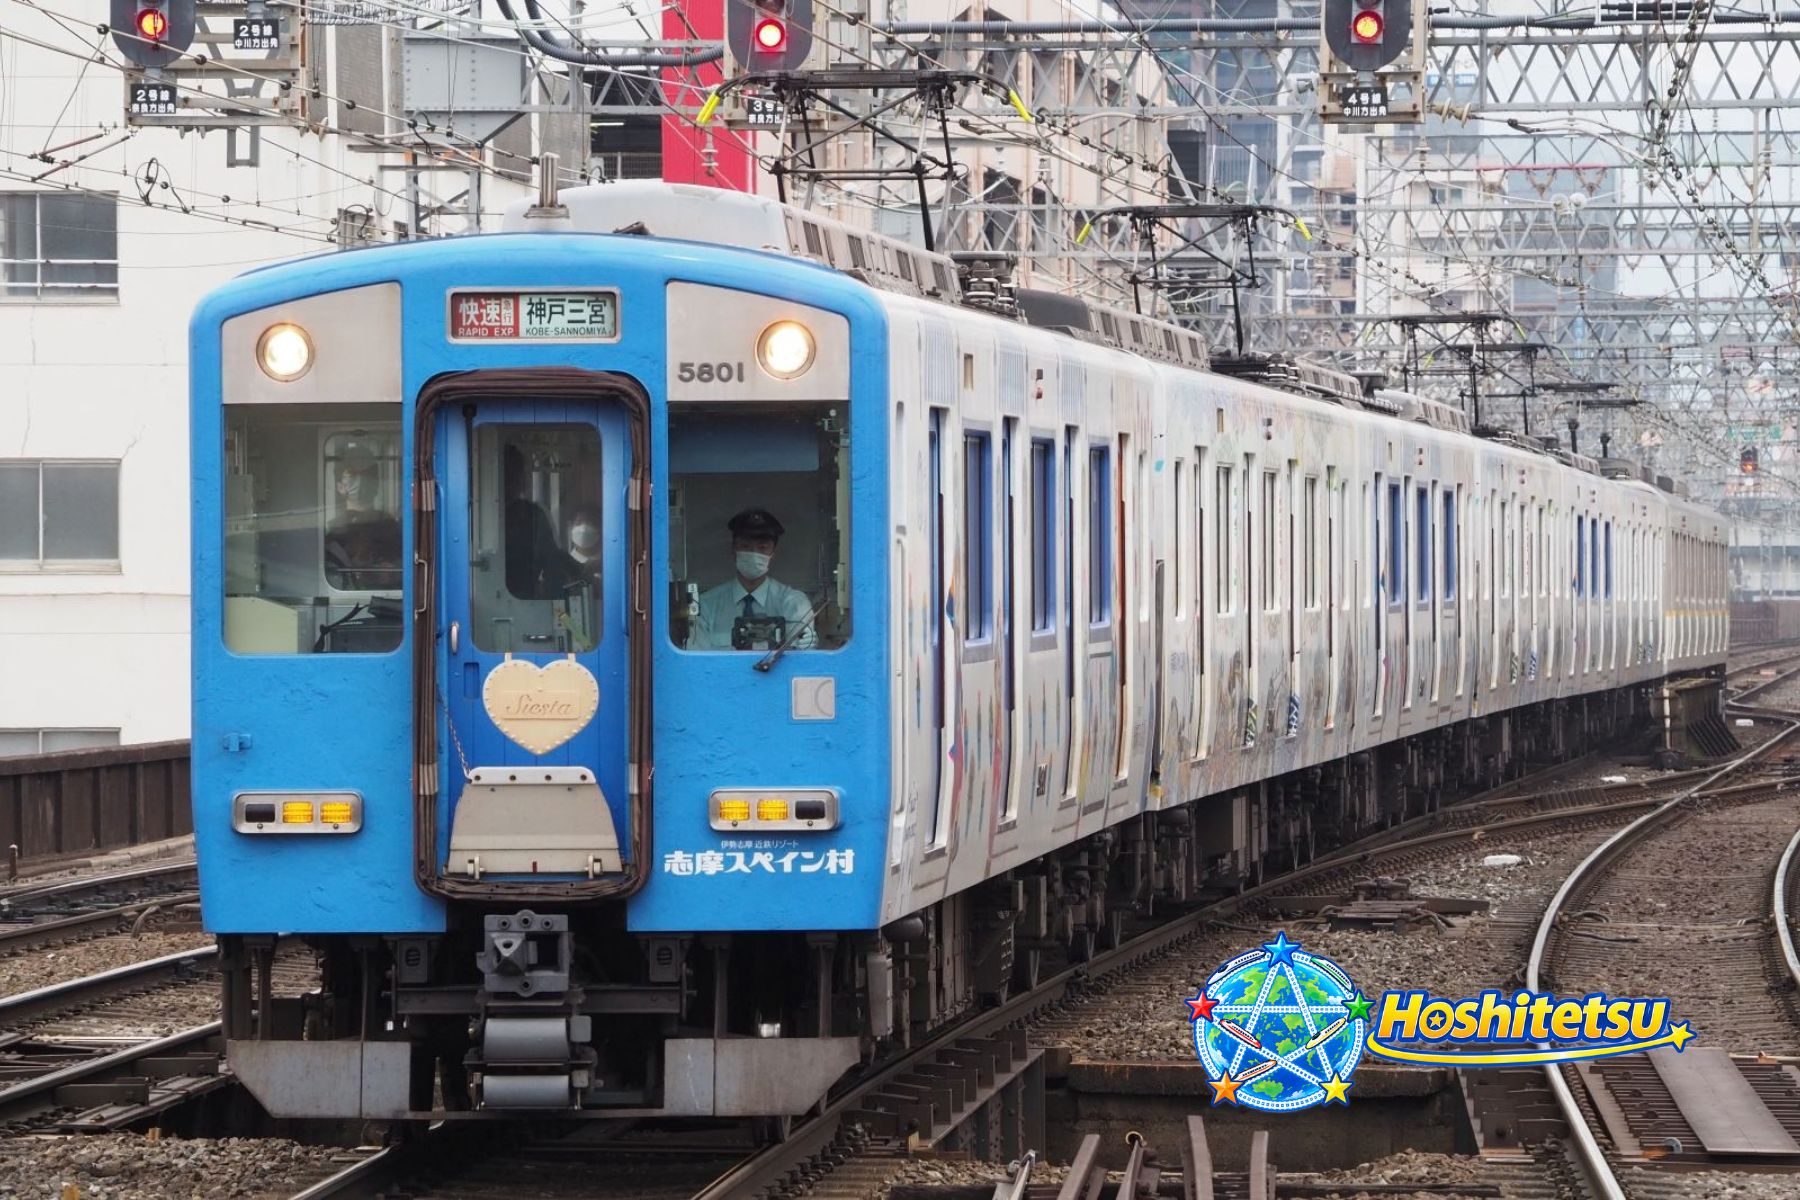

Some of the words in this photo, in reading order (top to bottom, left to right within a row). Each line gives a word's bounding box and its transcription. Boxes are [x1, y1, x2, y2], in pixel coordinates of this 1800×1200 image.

[239, 25, 273, 36] 2号線
[234, 38, 278, 48] 中川方出発
[136, 89, 170, 101] 2号線
[1348, 92, 1382, 104] 4号線
[1343, 106, 1387, 116] 中川方出発
[526, 297, 607, 325] 神戸三宮
[458, 327, 489, 337] RAPID
[678, 361, 744, 383] 5801
[506, 693, 572, 715] Siesta
[664, 849, 855, 875] 志摩スペイン村
